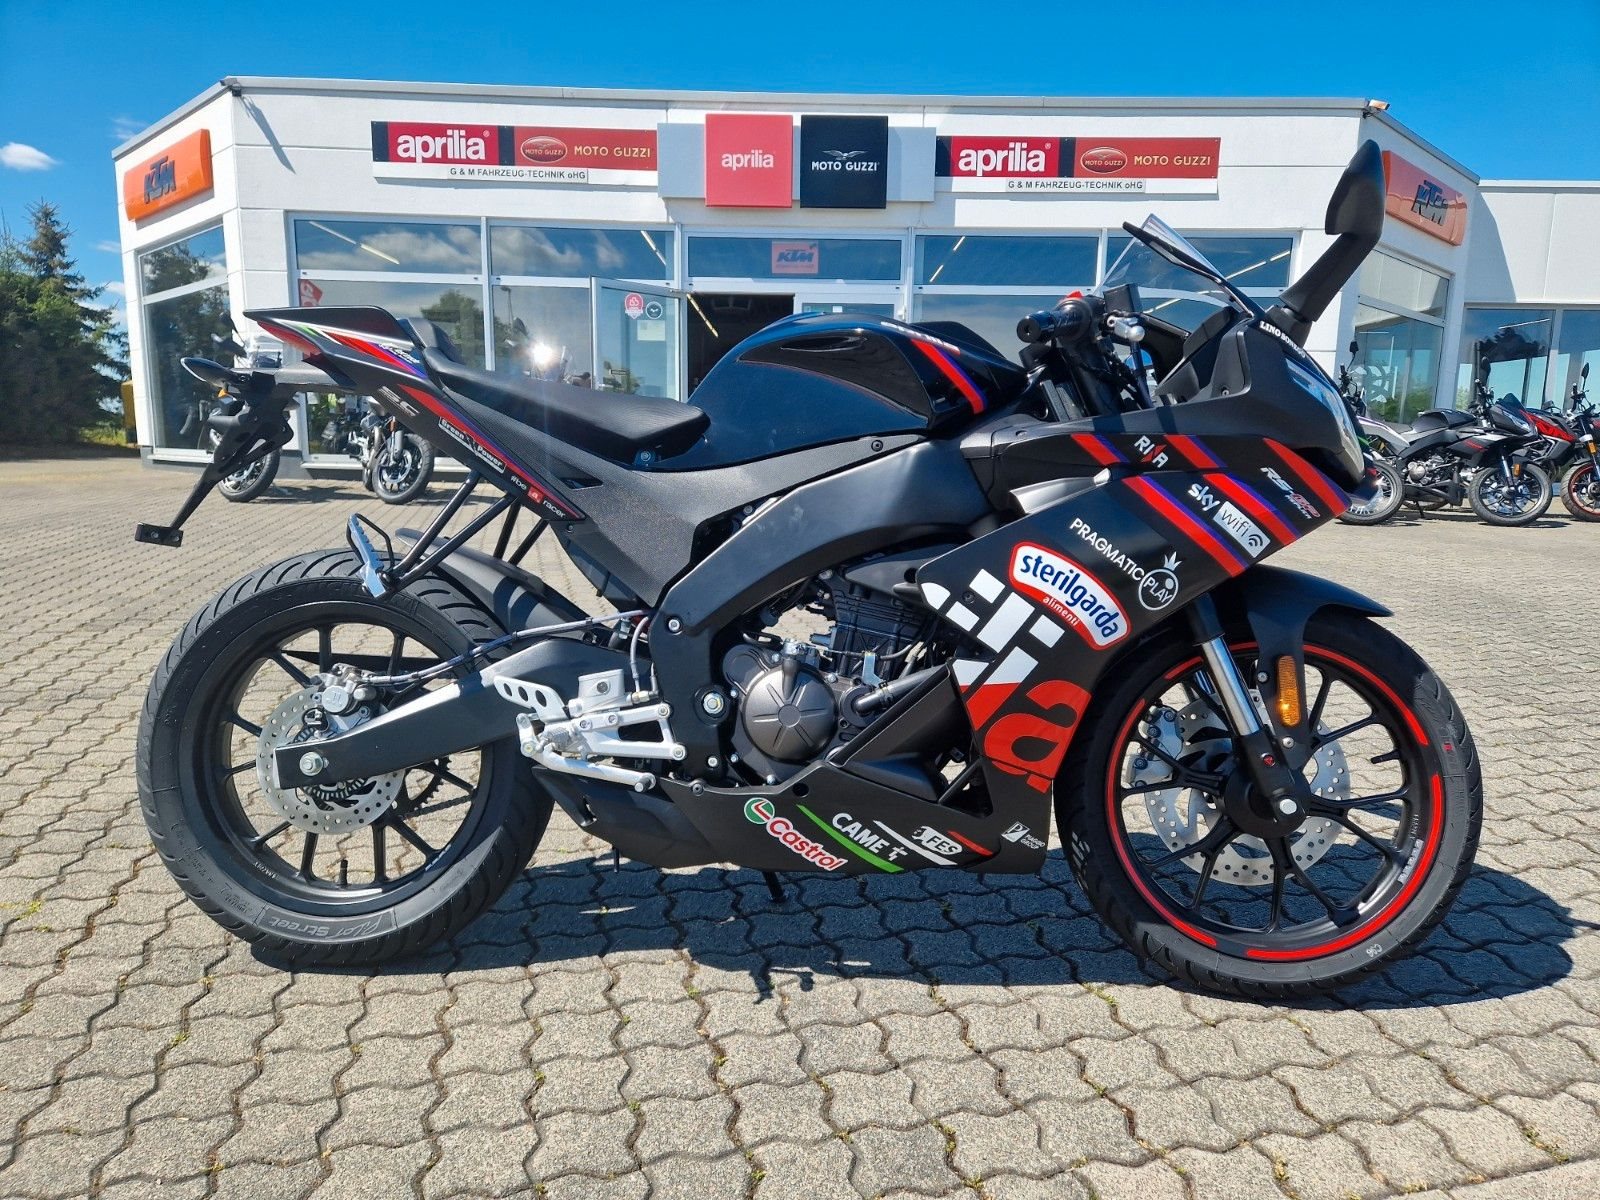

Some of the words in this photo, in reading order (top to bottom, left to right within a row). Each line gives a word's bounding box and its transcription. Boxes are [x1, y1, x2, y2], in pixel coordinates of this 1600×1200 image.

[396, 129, 485, 163] aprilia
[524, 147, 544, 156] MOTO
[574, 145, 609, 157] MOTO
[614, 146, 651, 158] GUZZI
[721, 149, 774, 171] aprilia
[811, 161, 841, 171] MOTO
[845, 161, 878, 171] GUZZI
[958, 142, 1046, 176] aprilia
[1085, 159, 1103, 167] MOTO
[1104, 160, 1123, 168] GUZZI
[1134, 155, 1169, 166] MOTO
[1174, 156, 1211, 166] GUZZI
[144, 156, 177, 205] KTM
[450, 168, 457, 176] G
[459, 168, 466, 176] &
[468, 168, 476, 176] M
[477, 169, 566, 180] FAHRZEUG-TECHNIK
[567, 172, 586, 180] oHG
[1008, 181, 1015, 189] G
[1017, 181, 1024, 189] &
[1025, 181, 1033, 189] M
[1034, 181, 1122, 190] FAHRZEUG-TECHNIK
[1124, 181, 1143, 190] oHG
[1410, 180, 1449, 226] KTM
[776, 249, 815, 263] KTM
[1260, 321, 1281, 336] LINO
[477, 445, 504, 467] Power
[542, 499, 567, 519] racer
[1187, 482, 1220, 512] sky
[1221, 506, 1250, 537] wifi
[1069, 517, 1145, 582] PRAGMATIC
[1020, 554, 1120, 639] sterilgarda
[1143, 575, 1173, 604] PLAY
[1042, 595, 1080, 628] alimenti
[767, 817, 848, 872] Castrol
[832, 813, 887, 855] CAME
